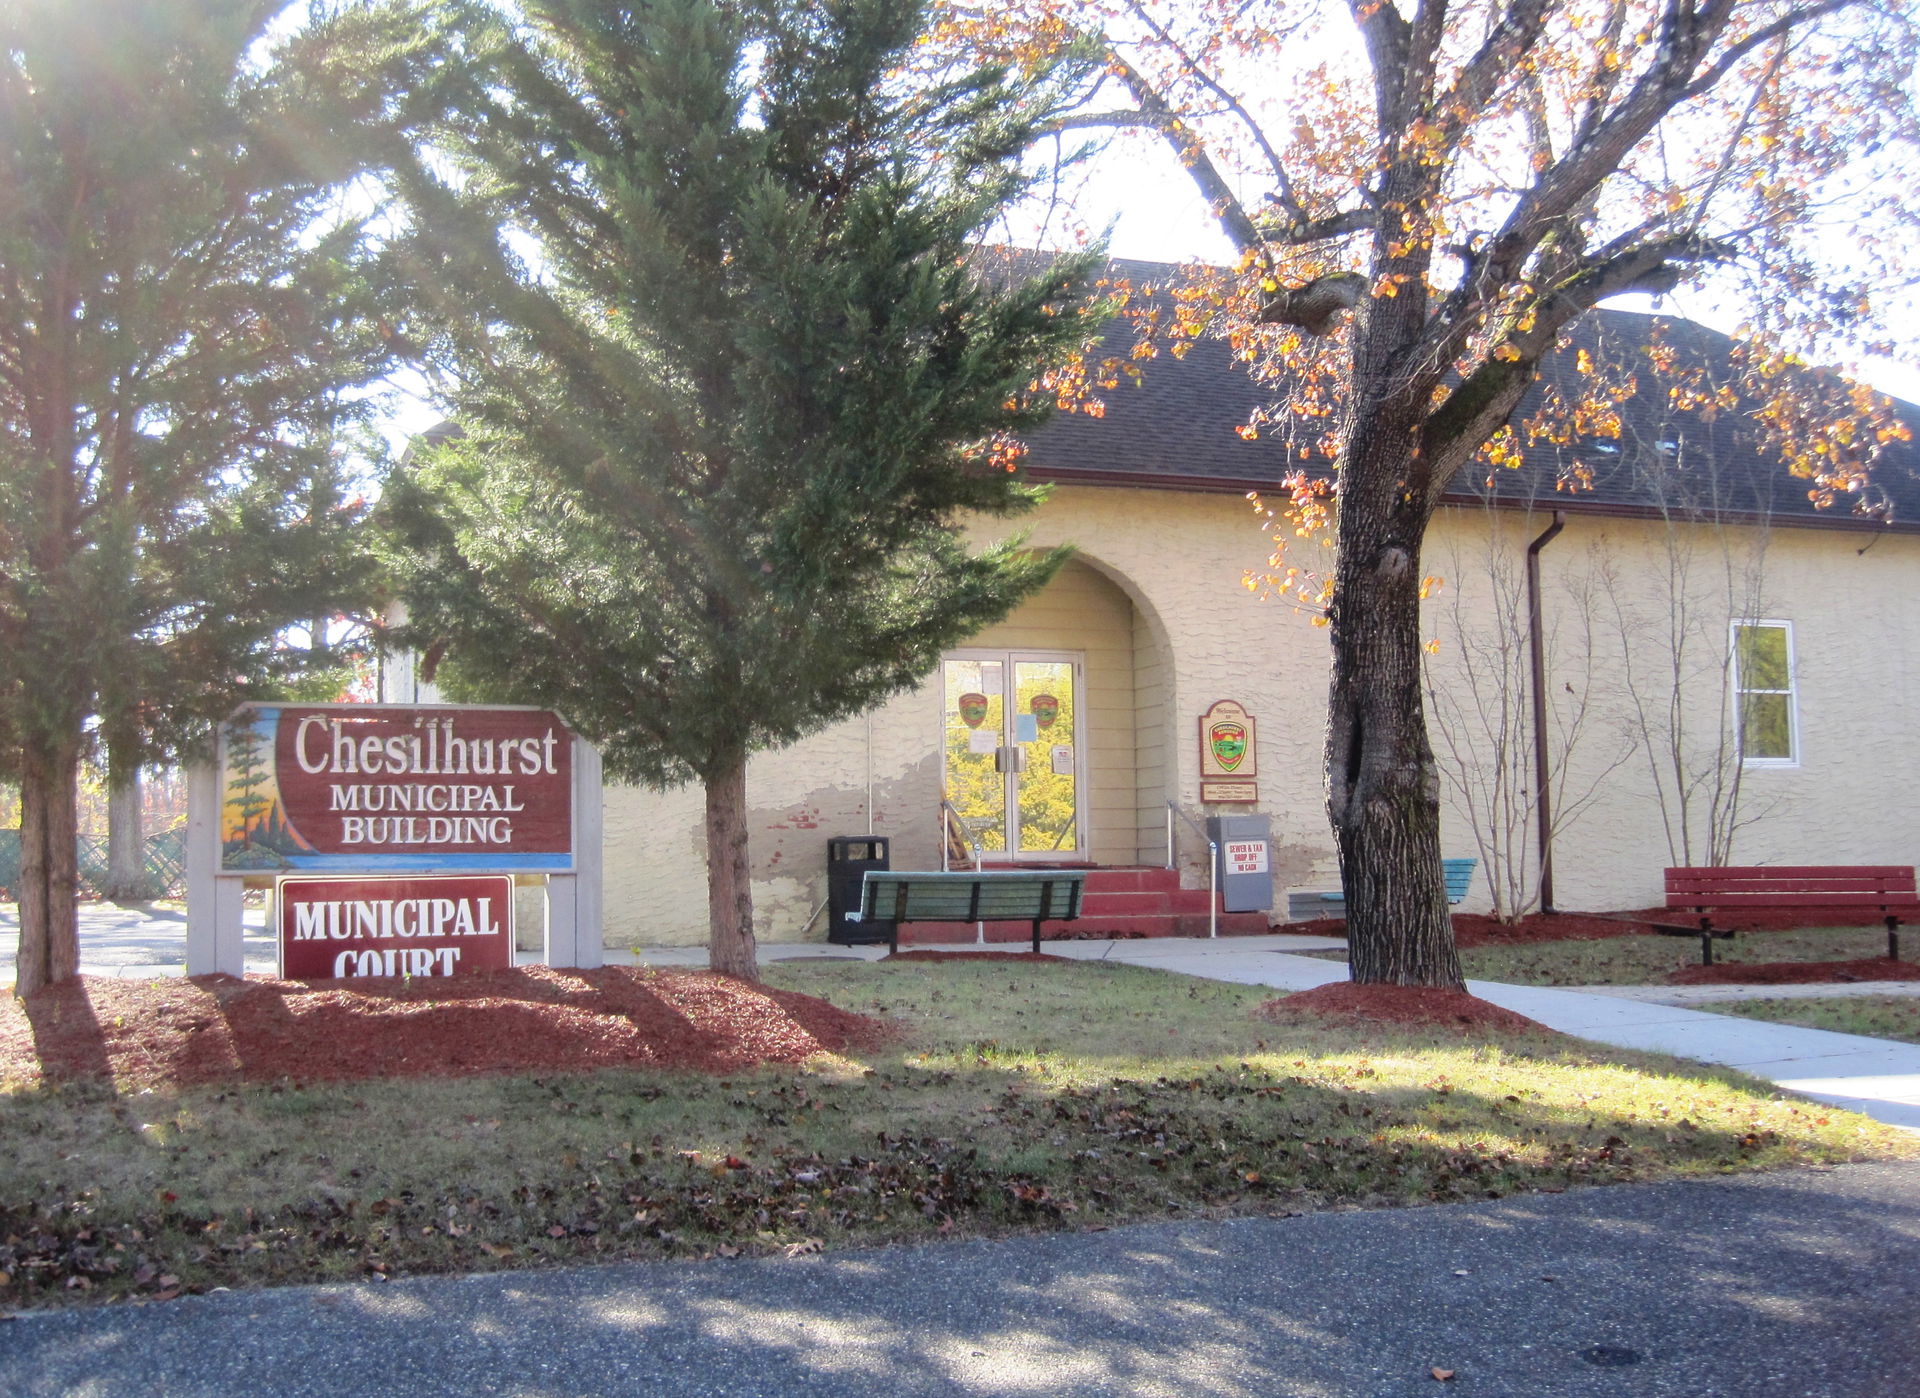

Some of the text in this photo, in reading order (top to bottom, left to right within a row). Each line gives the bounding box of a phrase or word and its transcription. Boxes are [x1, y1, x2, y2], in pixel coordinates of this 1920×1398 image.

[296, 715, 558, 775] Chesilhurst
[330, 785, 524, 812] MUNICIPAL
[342, 817, 512, 844] BUILDING
[1229, 845, 1247, 853] SEWER
[1253, 844, 1263, 852] TAX
[1248, 853, 1257, 861] OFF
[293, 897, 498, 941] MUNICIPAL
[334, 947, 460, 978] COURT
